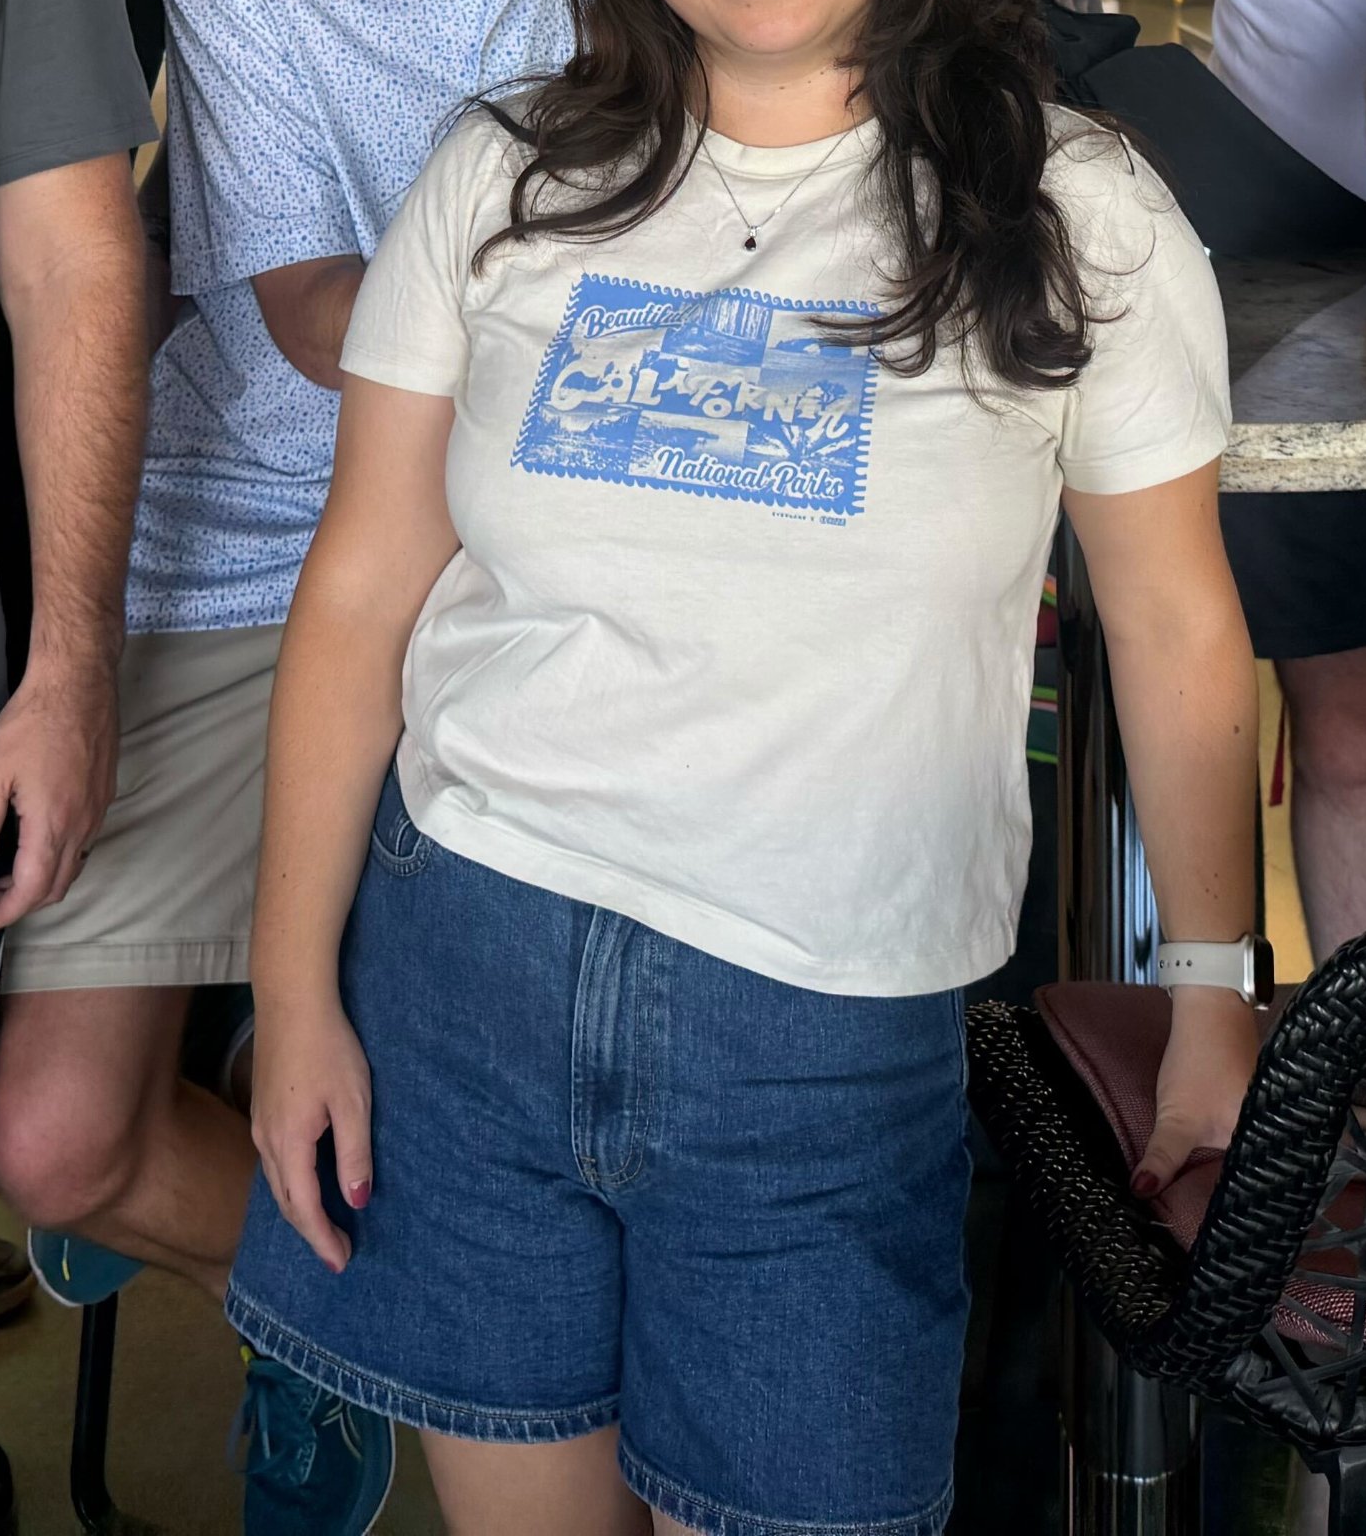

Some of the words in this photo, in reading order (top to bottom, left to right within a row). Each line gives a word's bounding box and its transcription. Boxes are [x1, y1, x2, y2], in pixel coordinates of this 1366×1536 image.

[579, 302, 699, 340] Beautiful
[653, 445, 771, 490] National
[768, 460, 846, 500] Parks
